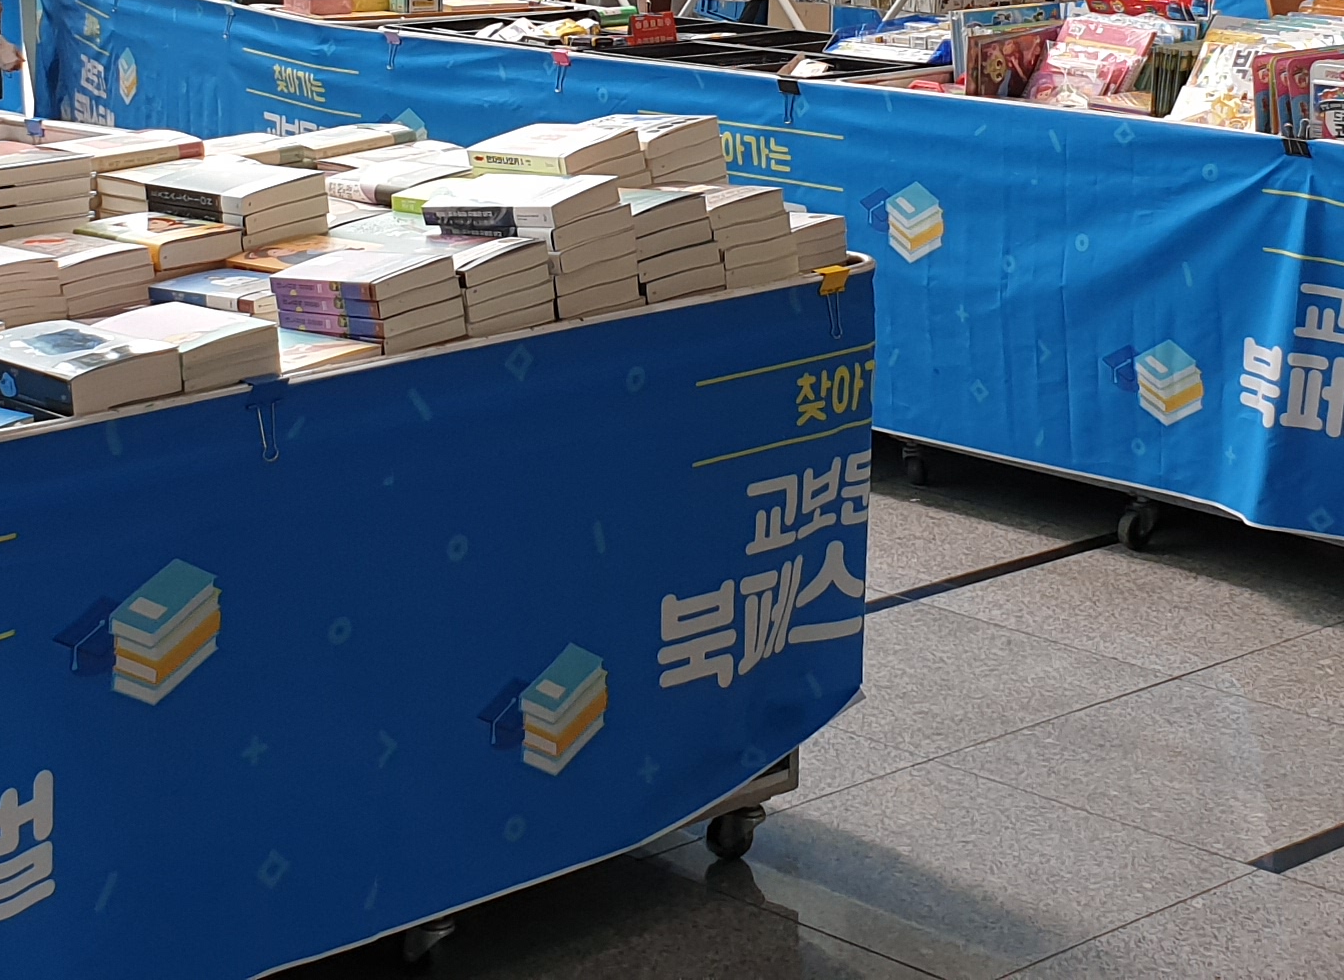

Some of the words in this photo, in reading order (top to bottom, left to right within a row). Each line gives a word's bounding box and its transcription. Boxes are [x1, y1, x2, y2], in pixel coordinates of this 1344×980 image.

[273, 63, 327, 103] 찾아가는
[721, 130, 792, 173] 아가는
[796, 360, 875, 426] 찾아
[745, 449, 872, 556] 교보문
[657, 539, 865, 689] 북페스
